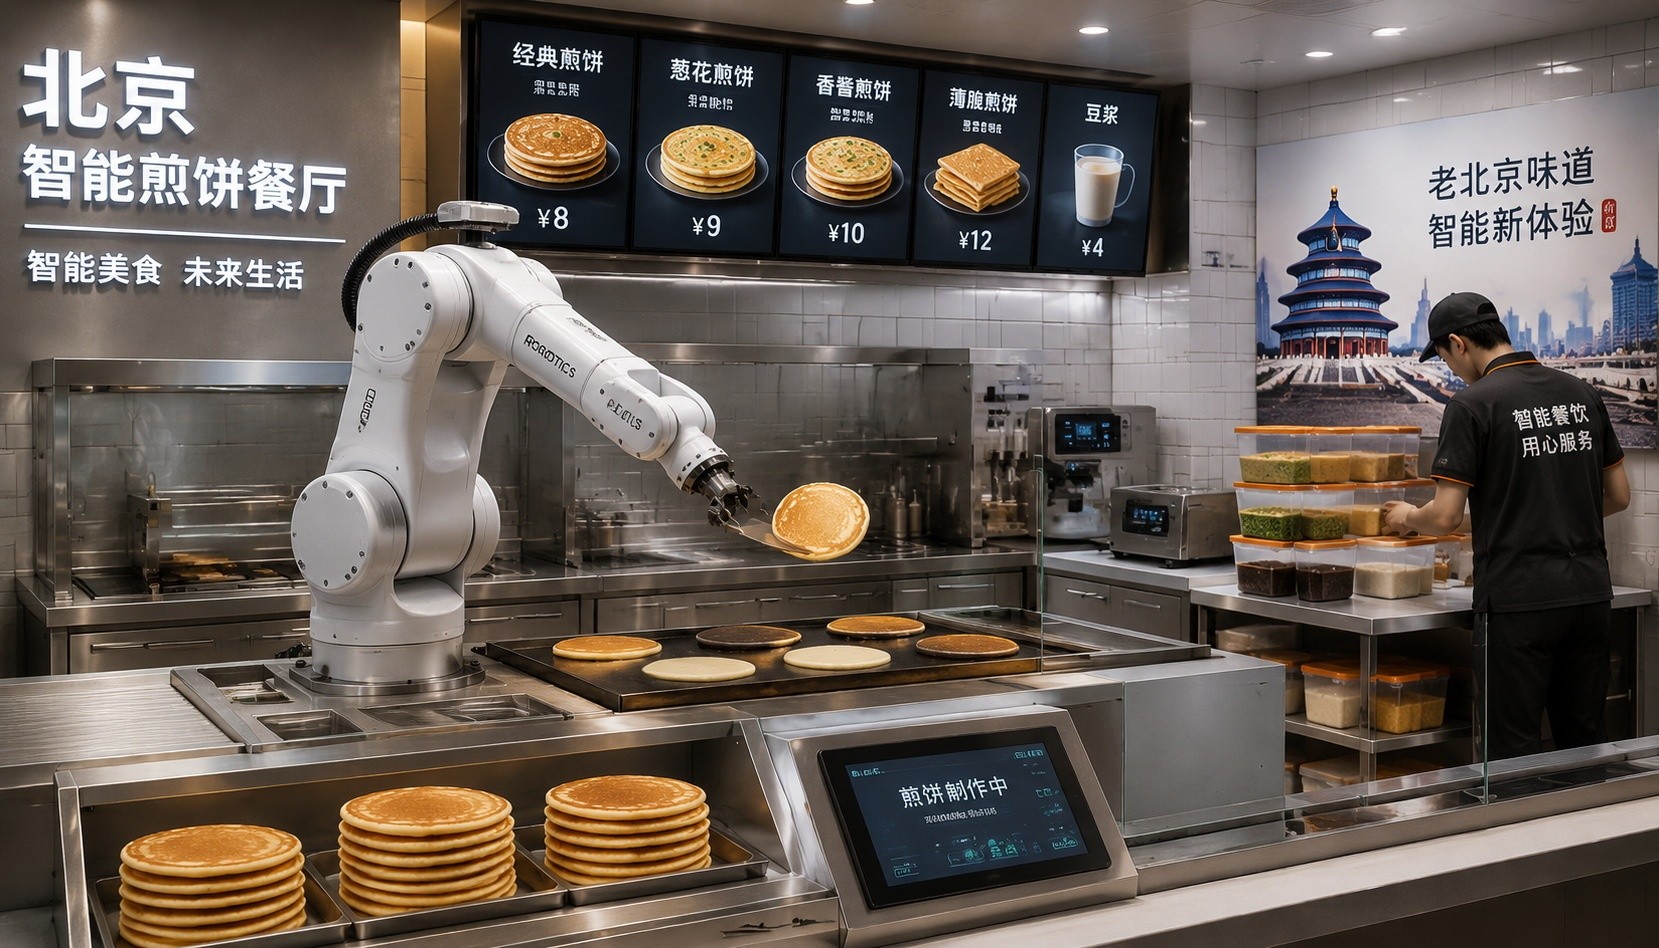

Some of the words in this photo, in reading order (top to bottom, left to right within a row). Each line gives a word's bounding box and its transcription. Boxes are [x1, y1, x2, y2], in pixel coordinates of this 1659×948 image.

[513, 41, 603, 73] 经典煎饼
[670, 58, 754, 88] 葱花煎饼
[22, 48, 195, 135] 北京
[1084, 103, 1119, 125] 豆浆
[22, 143, 347, 214] 智能煎饼餐厅
[1428, 146, 1595, 201] 老北京味道
[537, 206, 569, 230] ¥8
[692, 214, 721, 237] ¥9
[1428, 198, 1594, 249] 智能新体验
[828, 222, 865, 244] ¥10
[958, 230, 992, 251] ¥12
[1081, 238, 1104, 257] ¥4
[27, 249, 163, 286] 智能美食
[183, 255, 304, 290] 未来生活
[1512, 402, 1590, 431] 智能餐饮
[1521, 429, 1593, 458] 用心服务
